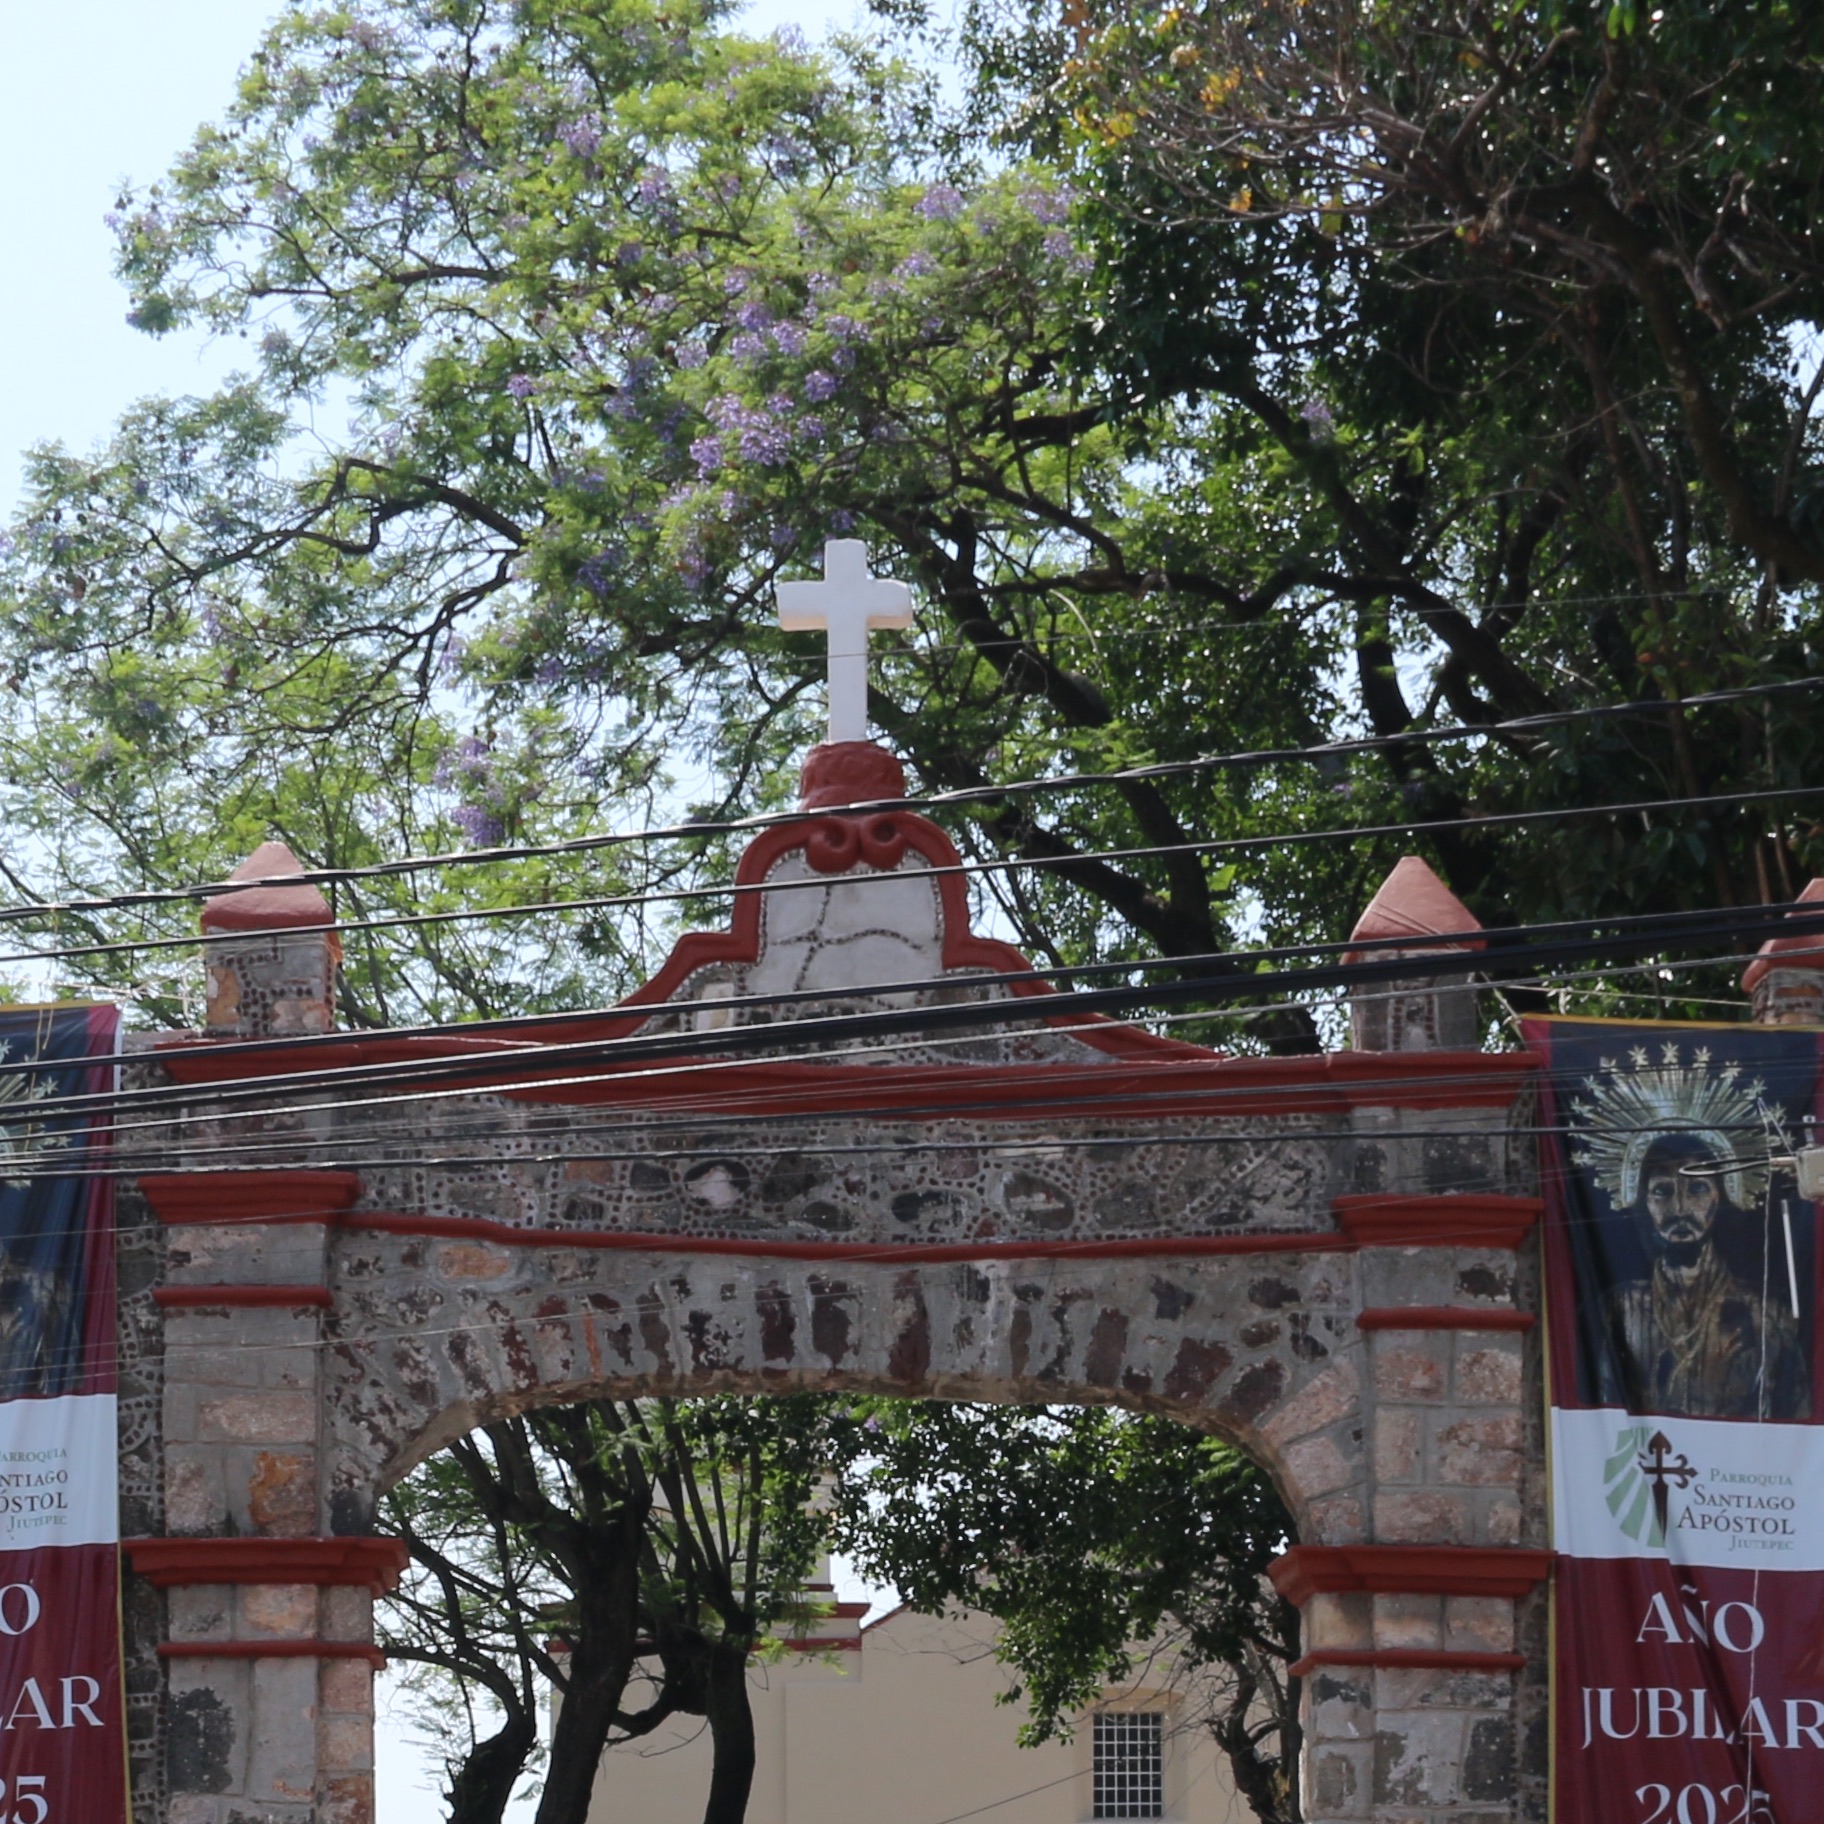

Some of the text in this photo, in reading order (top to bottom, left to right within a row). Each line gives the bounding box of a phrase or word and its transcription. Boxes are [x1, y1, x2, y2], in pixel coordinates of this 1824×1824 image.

[1709, 1467, 1793, 1486] PARROQUIA
[1693, 1484, 1795, 1511] SANTIAGO
[1677, 1504, 1795, 1535] APÓSTOL
[1728, 1534, 1795, 1551] JIUTEPEC
[1636, 1584, 1765, 1653] AÑO
